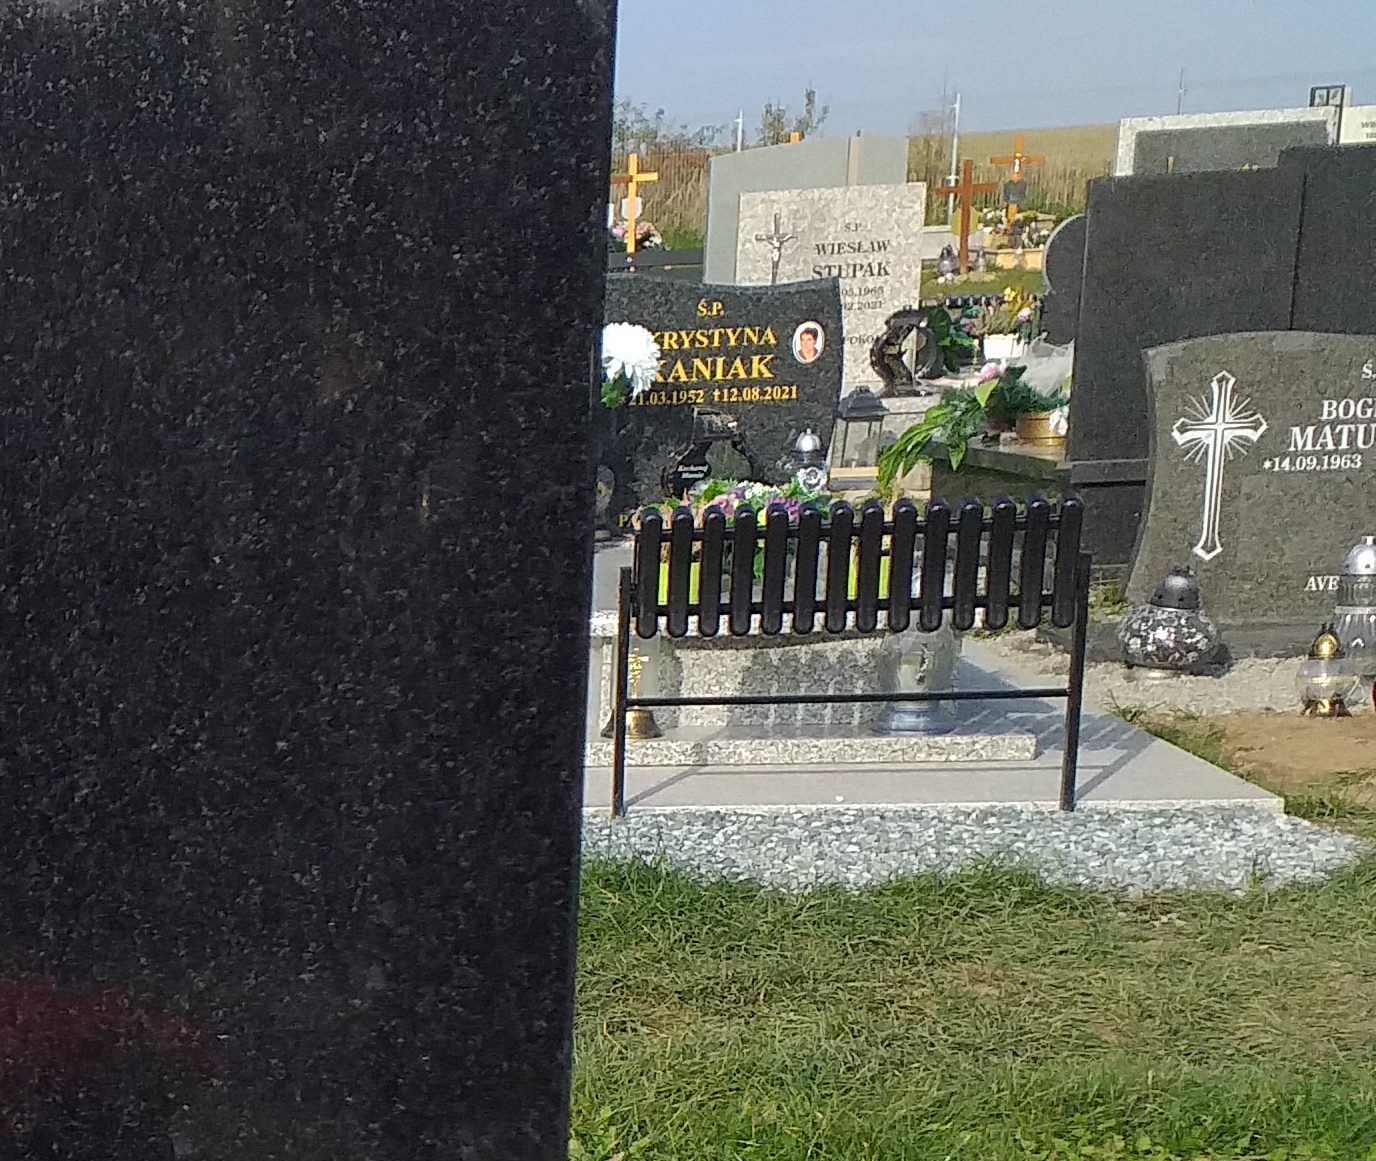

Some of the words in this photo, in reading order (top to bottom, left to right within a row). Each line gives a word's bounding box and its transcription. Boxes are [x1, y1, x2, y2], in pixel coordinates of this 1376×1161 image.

[812, 262, 891, 279] STUPAK
[697, 298, 725, 317] Ś.P.
[1319, 398, 1376, 421] BOG
[1288, 423, 1376, 451] MATU
[1303, 575, 1340, 592] AVE
